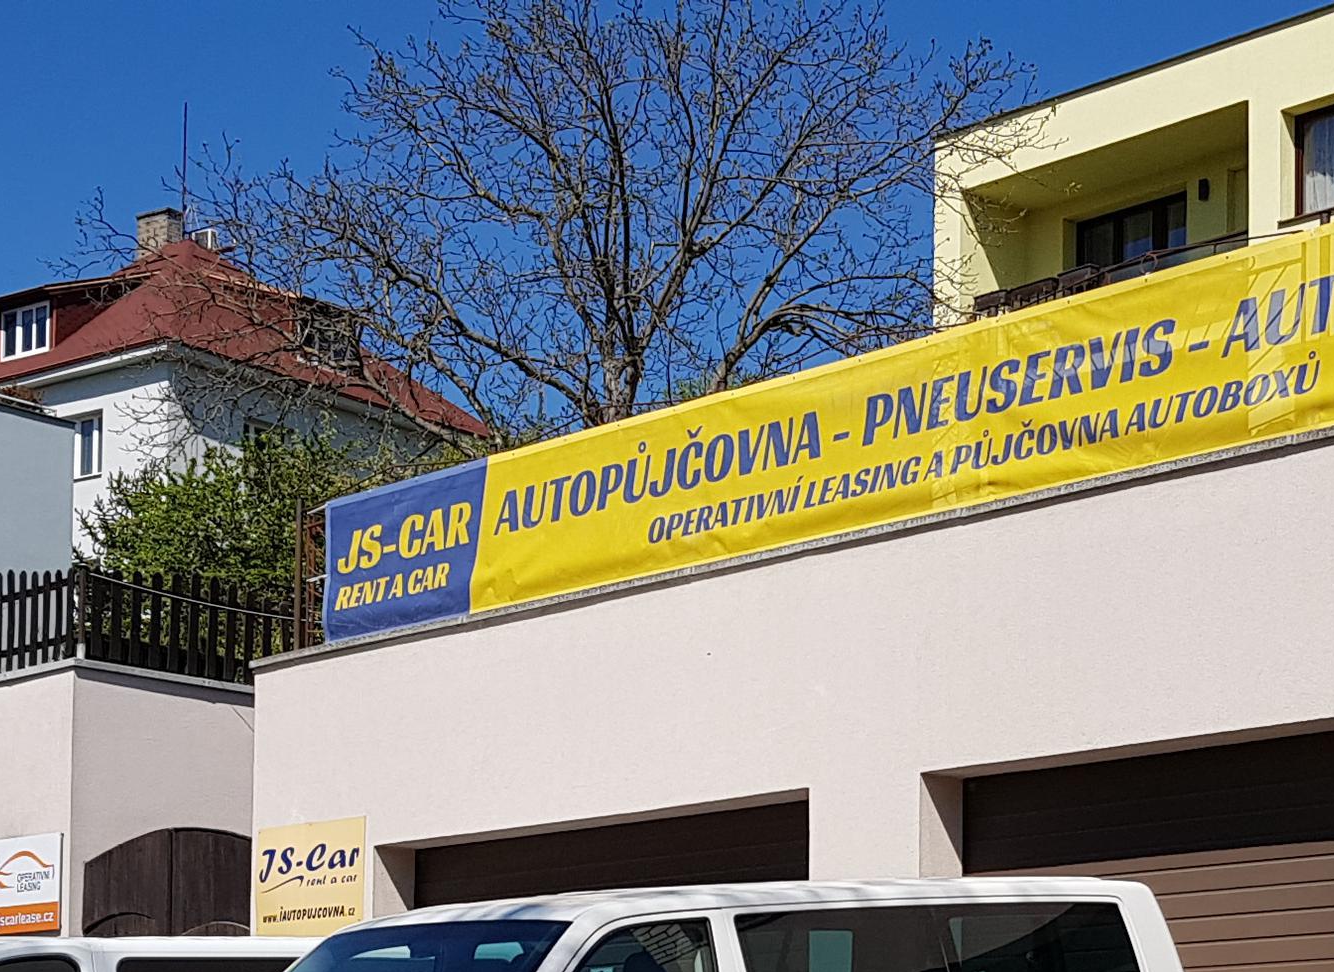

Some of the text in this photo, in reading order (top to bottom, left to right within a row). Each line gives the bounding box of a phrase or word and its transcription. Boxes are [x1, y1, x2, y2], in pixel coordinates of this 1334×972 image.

[493, 410, 822, 537] AUTOPŮJČOVNA
[862, 317, 1177, 447] PNEUSERVIS
[647, 349, 1322, 544] OPERATIVNÍ LEASING A PŮJČOVNA AUTOBOXŮ
[336, 501, 473, 575] JS-CAR
[334, 562, 450, 611] RENT A CAR
[258, 843, 360, 884] JS-Car
[306, 874, 358, 887] rent a car
